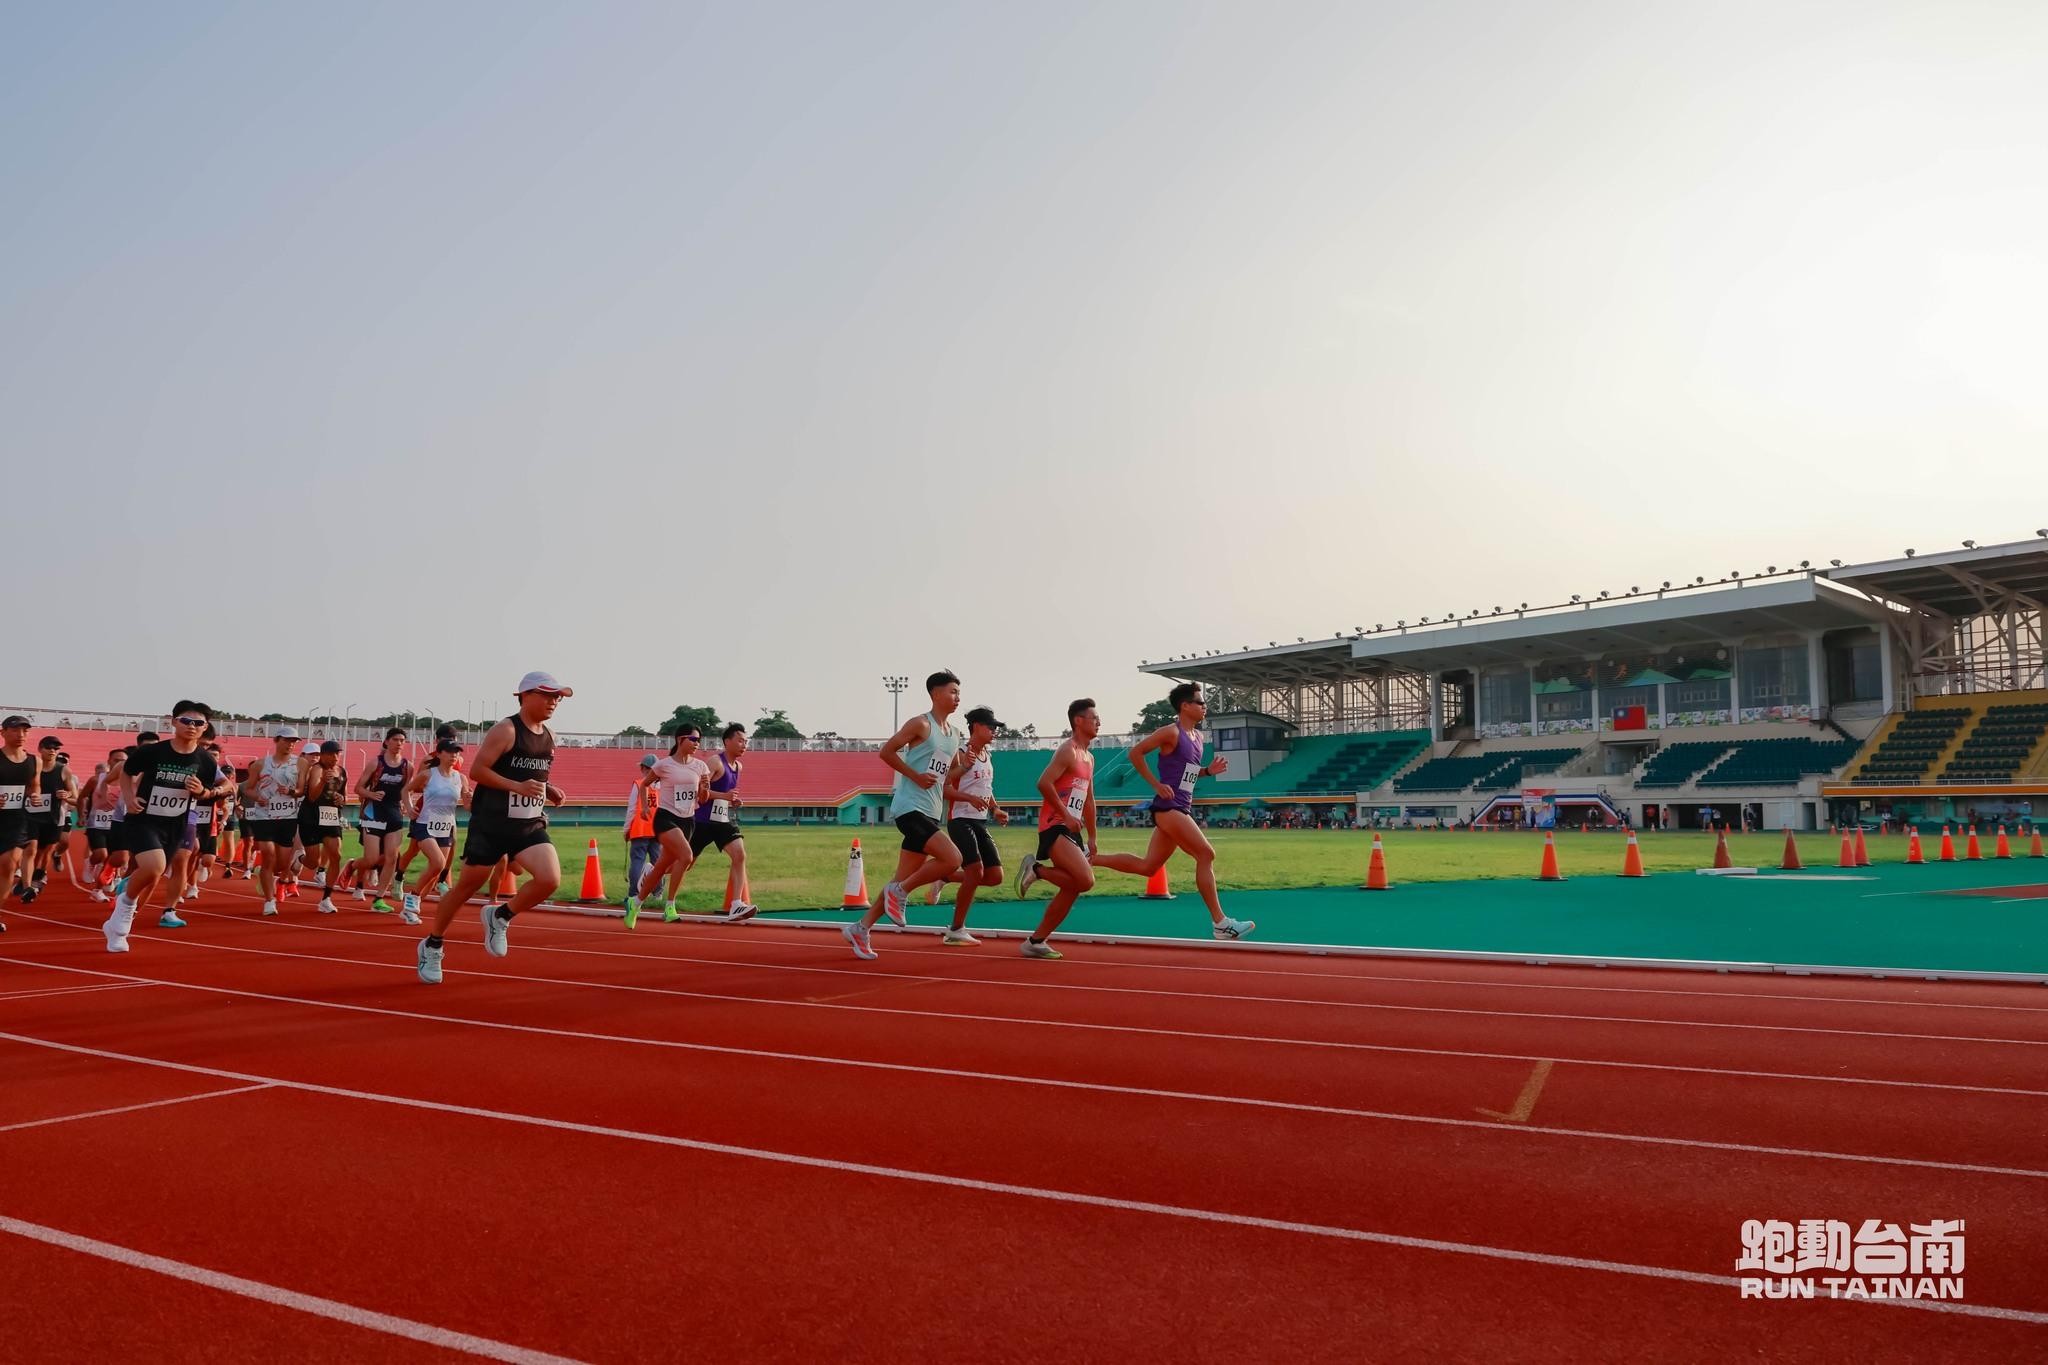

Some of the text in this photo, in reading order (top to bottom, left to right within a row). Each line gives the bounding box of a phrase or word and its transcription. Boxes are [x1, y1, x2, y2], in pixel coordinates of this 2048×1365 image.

[150, 795, 187, 809] 1007
[270, 801, 293, 811] 1054
[320, 811, 338, 821] 1005
[428, 820, 452, 832] 1020
